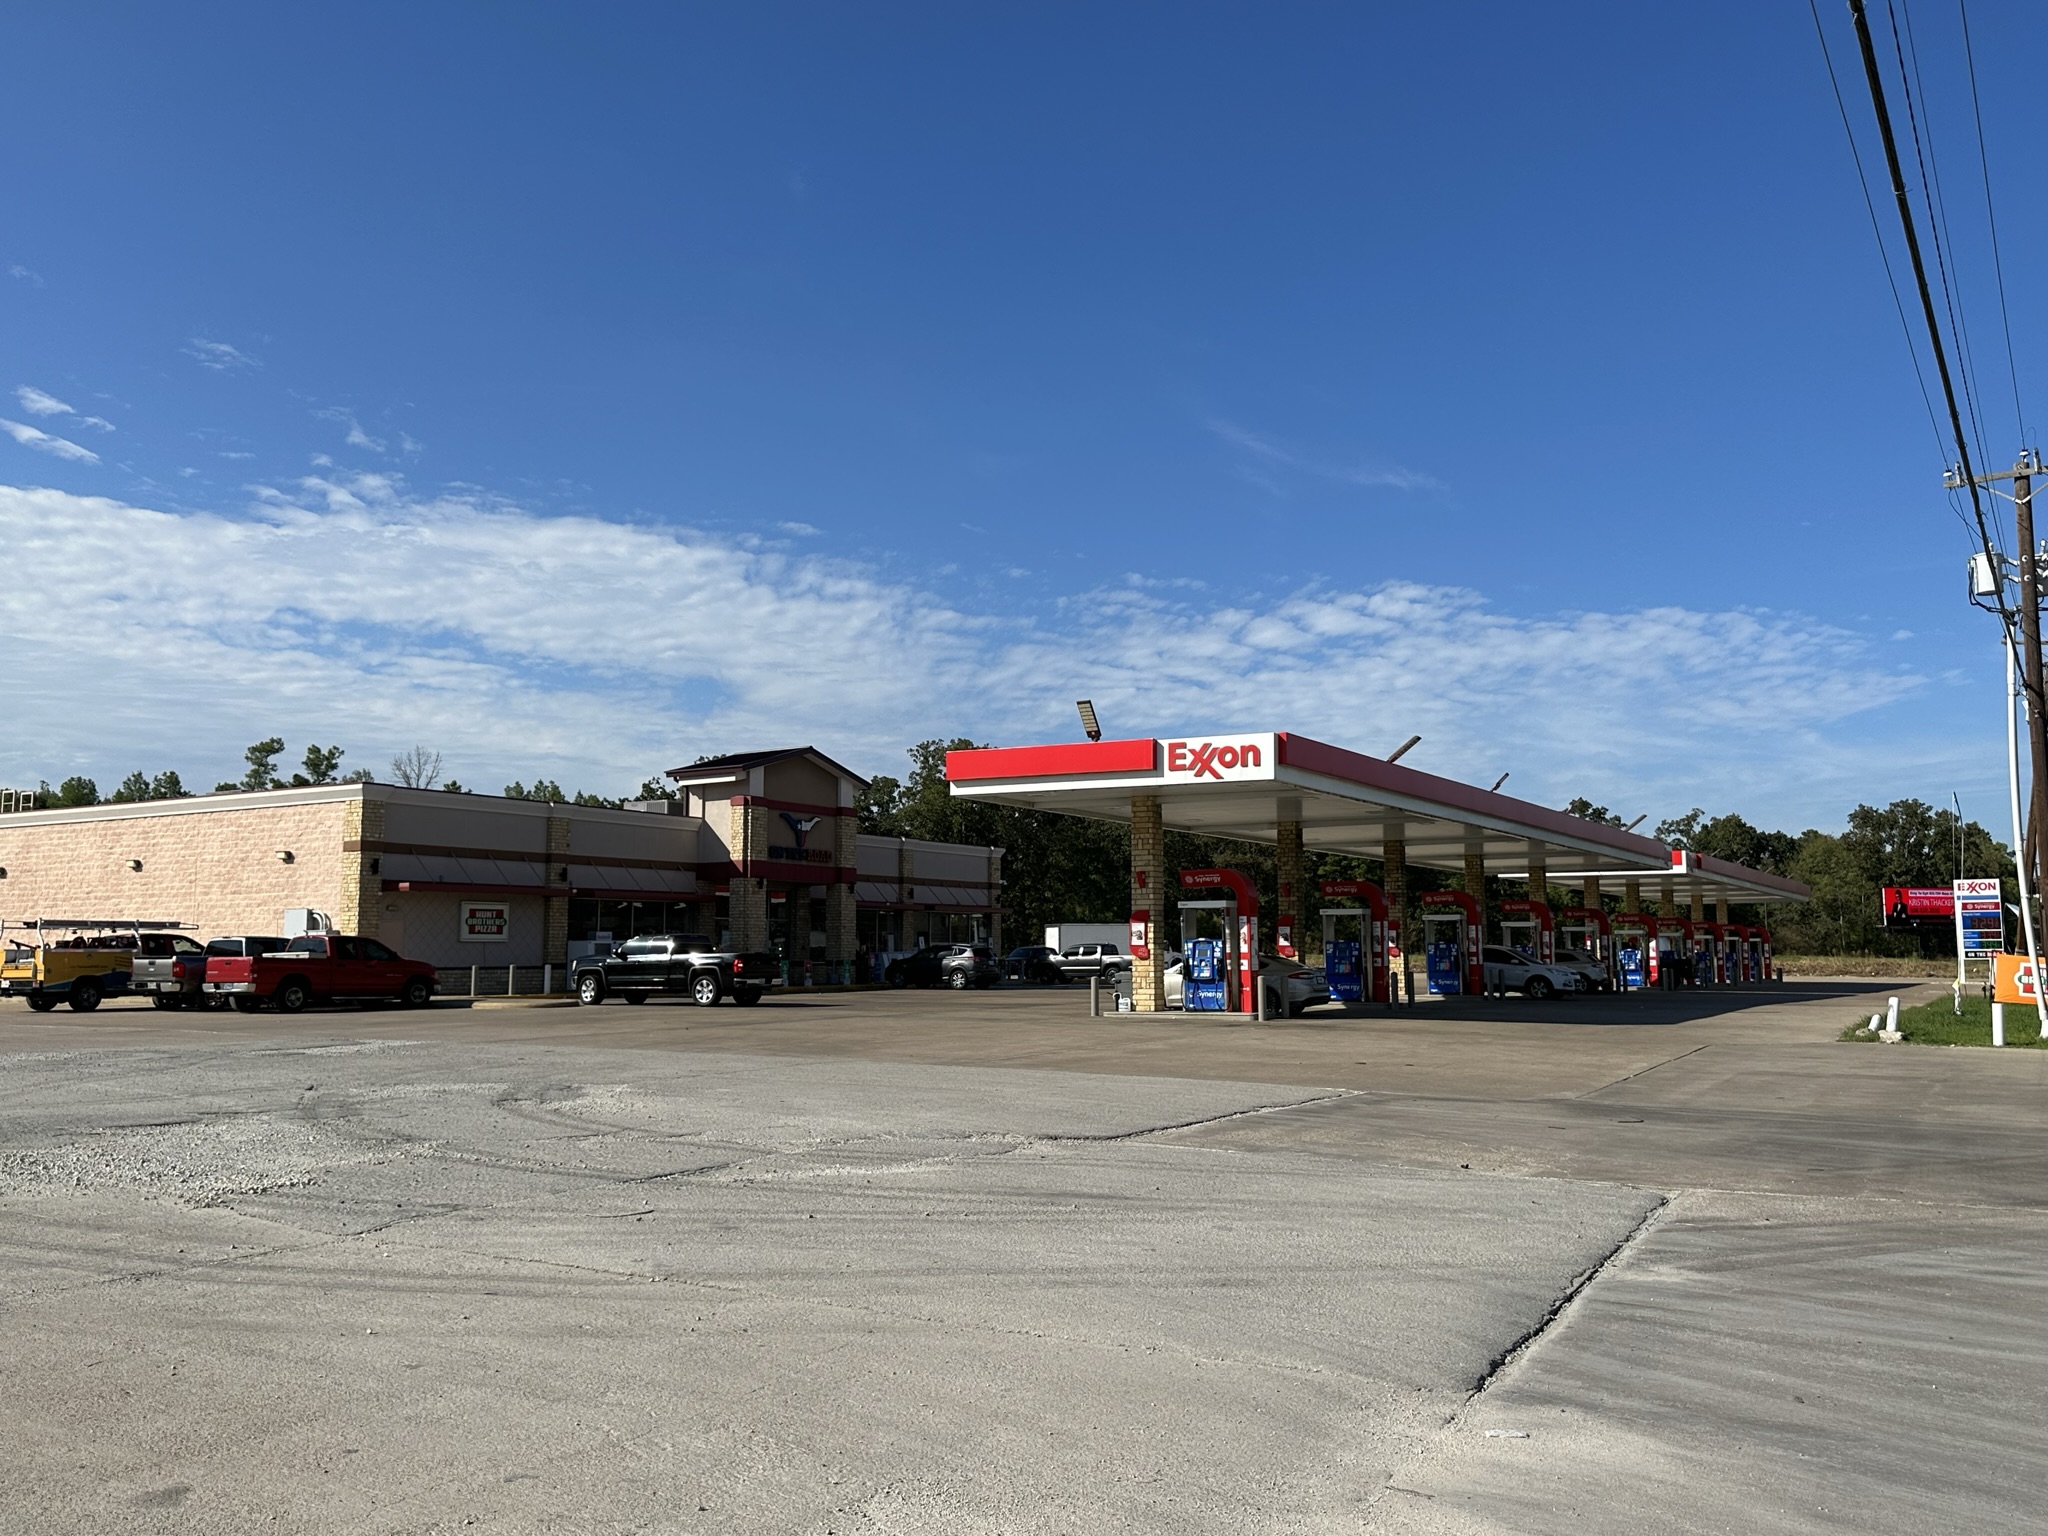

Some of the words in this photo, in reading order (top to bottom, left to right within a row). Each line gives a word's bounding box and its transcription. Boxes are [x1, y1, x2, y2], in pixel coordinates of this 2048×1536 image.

[1168, 742, 1261, 780] Exxon
[806, 849, 832, 862] ROAD
[1194, 875, 1221, 884] Synergy
[1957, 881, 1996, 894] EXXON
[1908, 898, 1930, 907] KRISTIN
[475, 910, 497, 918] HUNT
[467, 917, 505, 926] BROTHERS
[475, 925, 497, 933] PIZZA
[1337, 983, 1360, 991] Synergy
[1197, 990, 1222, 998] Synergy
